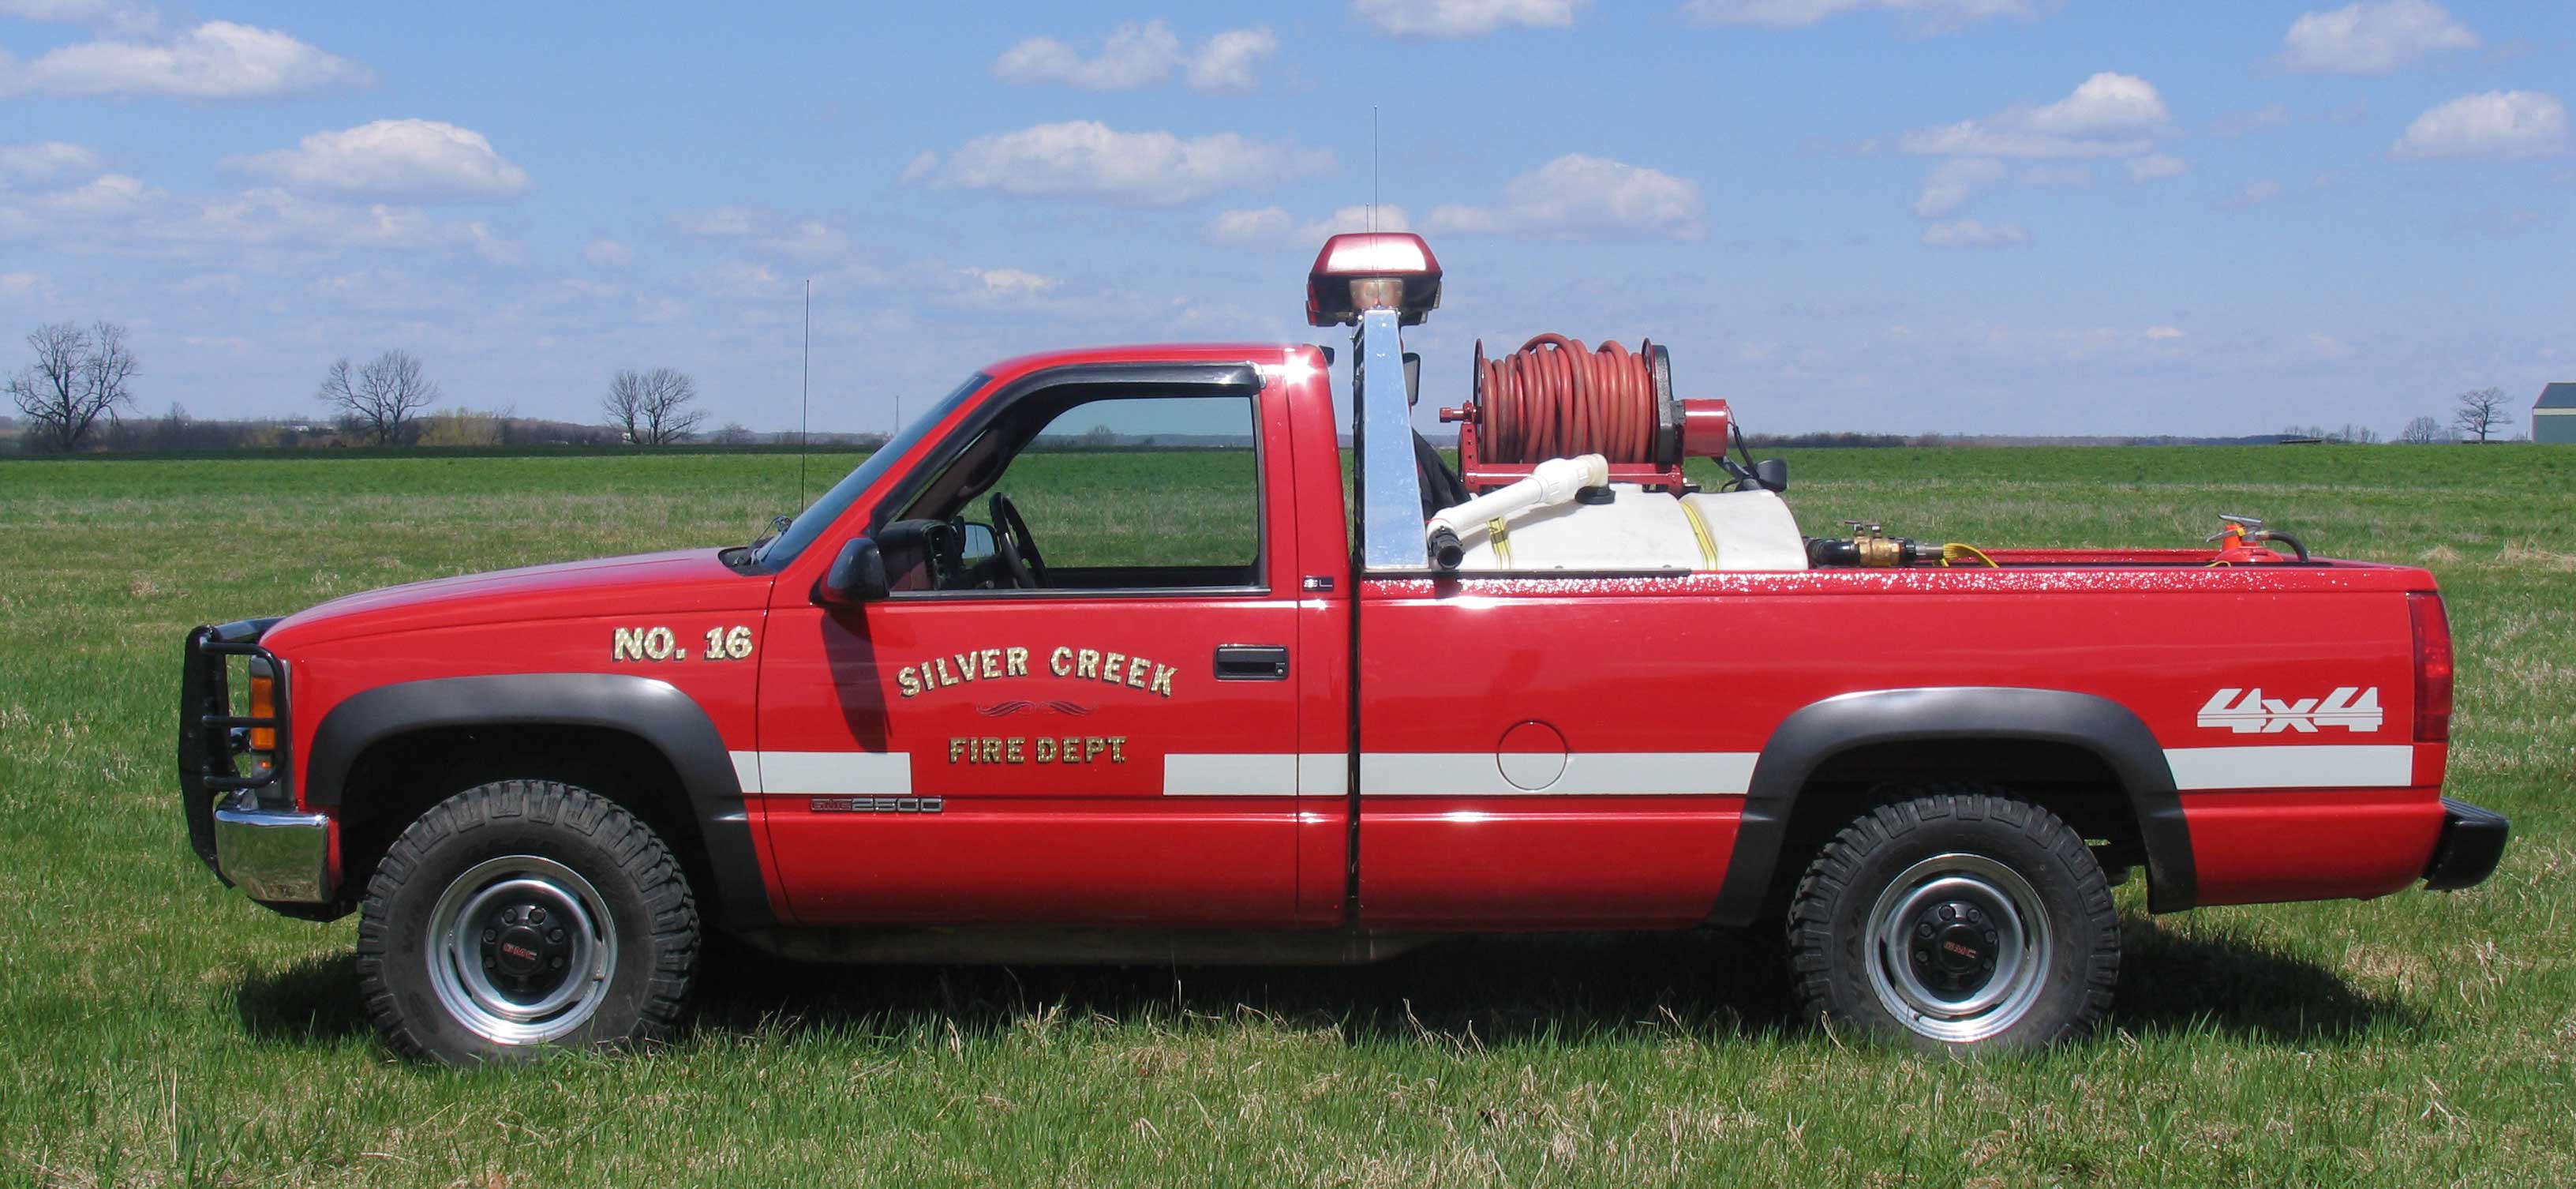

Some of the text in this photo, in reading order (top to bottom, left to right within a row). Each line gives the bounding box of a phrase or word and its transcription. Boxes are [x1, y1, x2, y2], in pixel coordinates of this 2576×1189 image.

[612, 625, 753, 662] NO. 16
[898, 646, 1178, 698] SILVER CREEK
[949, 737, 1126, 763] FIRE DEPT.
[852, 797, 942, 812] 2500
[504, 943, 537, 961] GMC
